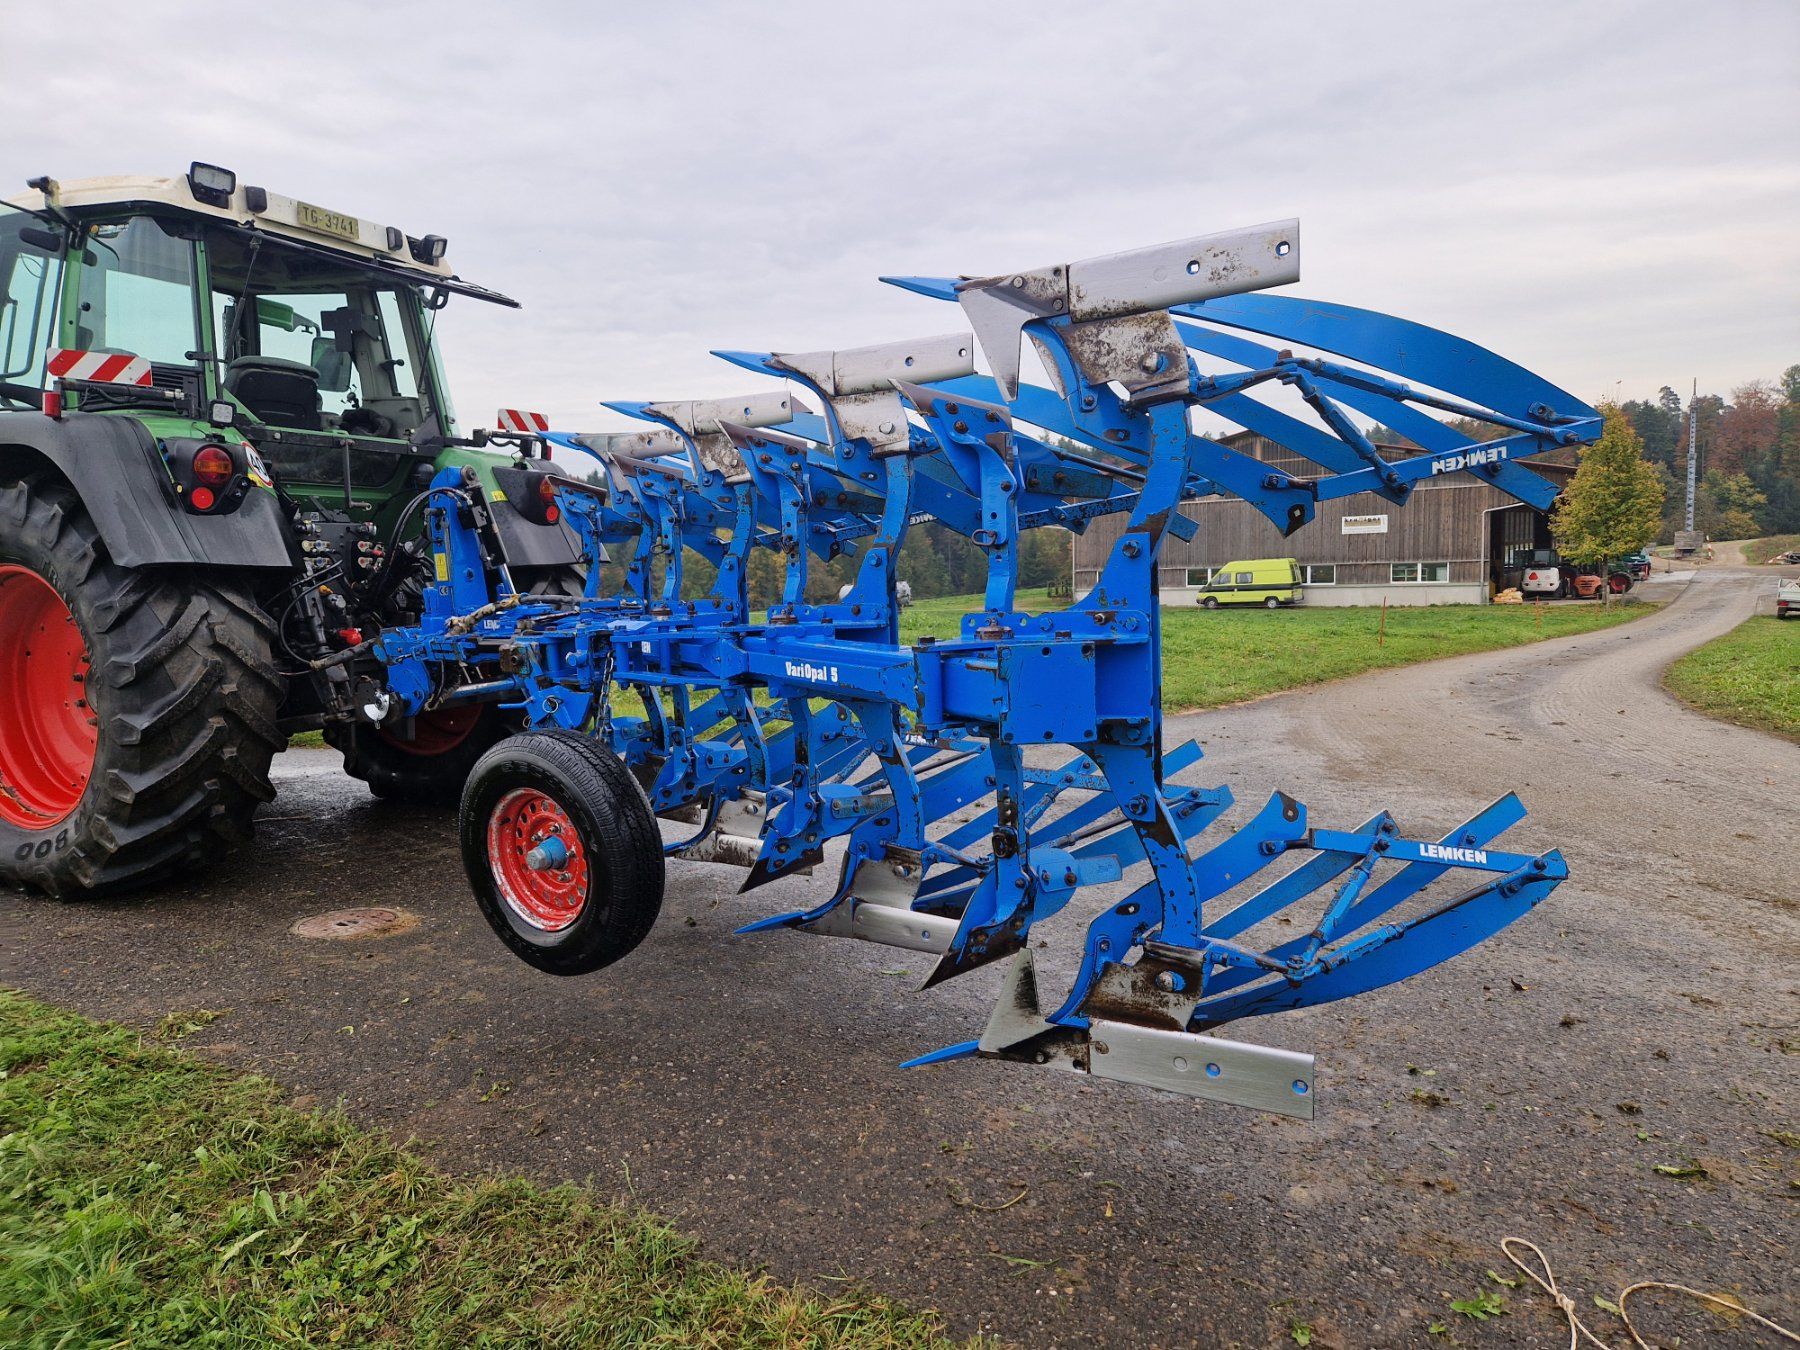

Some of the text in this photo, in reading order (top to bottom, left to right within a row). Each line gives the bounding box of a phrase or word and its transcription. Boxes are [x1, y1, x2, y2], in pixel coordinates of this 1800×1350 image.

[1431, 446, 1507, 475] LEMKEN
[784, 661, 838, 682] VariOpal 5
[1419, 843, 1487, 864] LEMKEN
